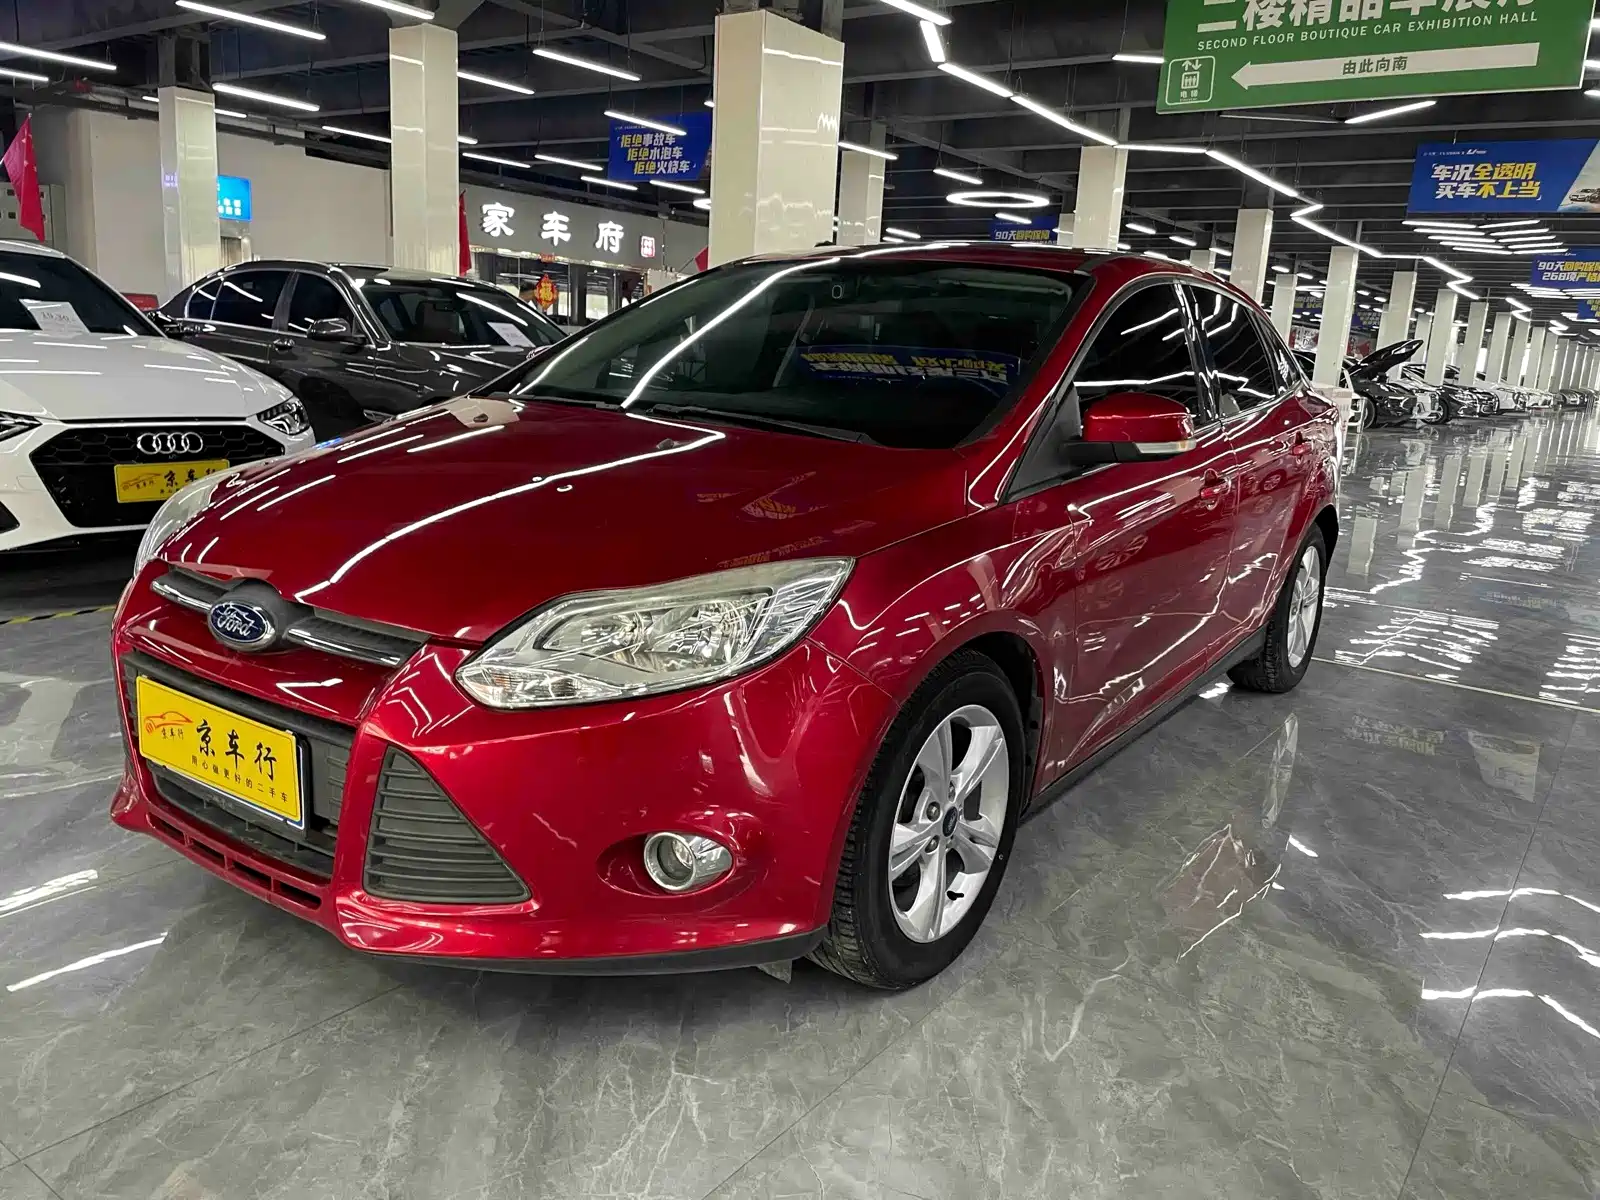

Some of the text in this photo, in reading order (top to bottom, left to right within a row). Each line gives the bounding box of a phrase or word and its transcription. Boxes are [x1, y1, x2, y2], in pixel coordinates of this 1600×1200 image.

[1198, 11, 1538, 50] SECOND FLOOR BOUTIQUE CAR EXHIBITION HALL
[1342, 56, 1408, 75] 由此向南
[621, 133, 676, 148] 拒绝事故车
[627, 147, 683, 161] 拒绝水泡车
[634, 160, 690, 175] 拒绝火烧车
[1431, 163, 1537, 181] 车况全透明
[1435, 181, 1541, 199] 买车不上当
[480, 201, 625, 254] 家车府
[216, 601, 262, 637] Ford
[196, 719, 277, 782] 京车行
